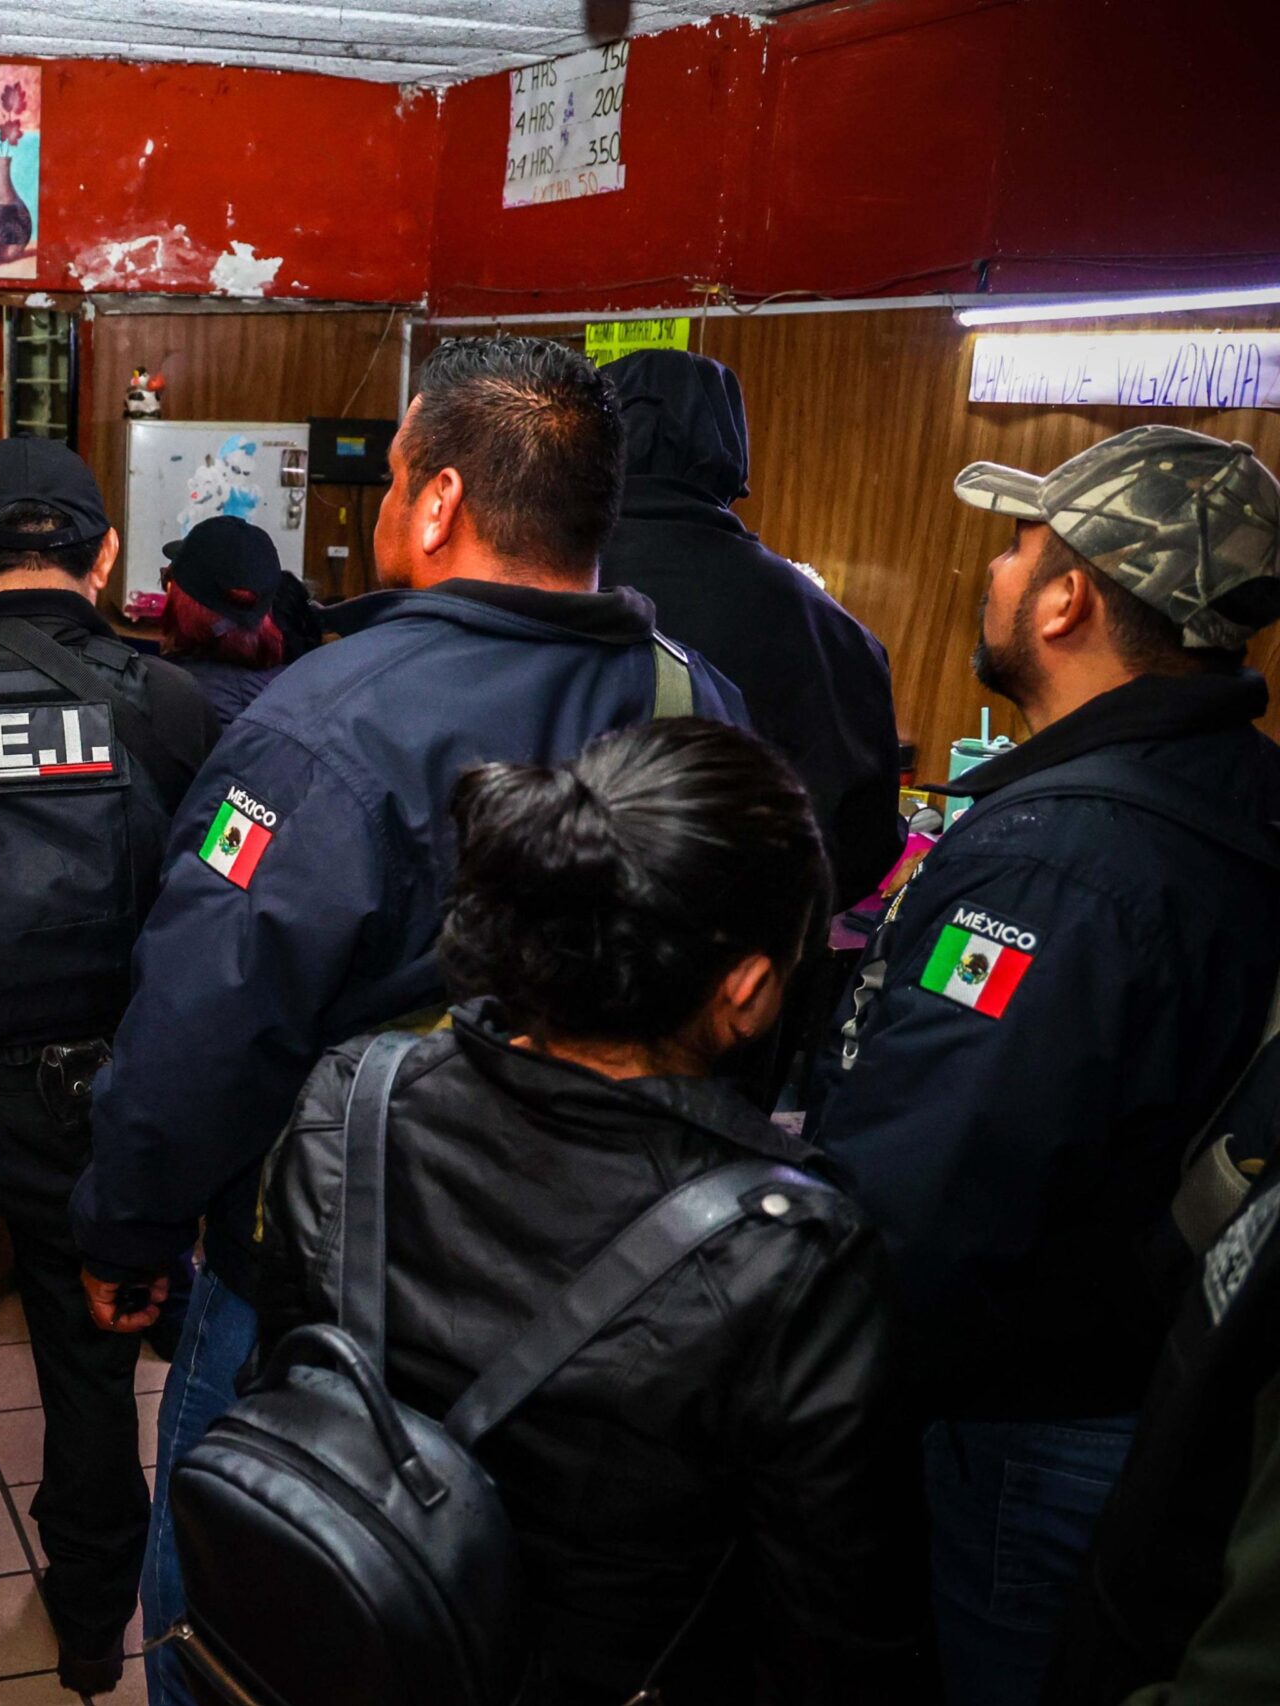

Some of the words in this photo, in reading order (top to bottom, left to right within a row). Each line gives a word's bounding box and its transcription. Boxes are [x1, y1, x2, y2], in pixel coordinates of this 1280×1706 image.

[515, 111, 526, 137] 4
[528, 101, 556, 135] HRS
[592, 82, 624, 118] 200
[508, 154, 528, 182] 24
[530, 145, 555, 177] HRS
[586, 131, 620, 167] 350
[578, 171, 599, 196] 50
[226, 785, 277, 827] MÉXICO
[952, 907, 1036, 950] MÉXICO
